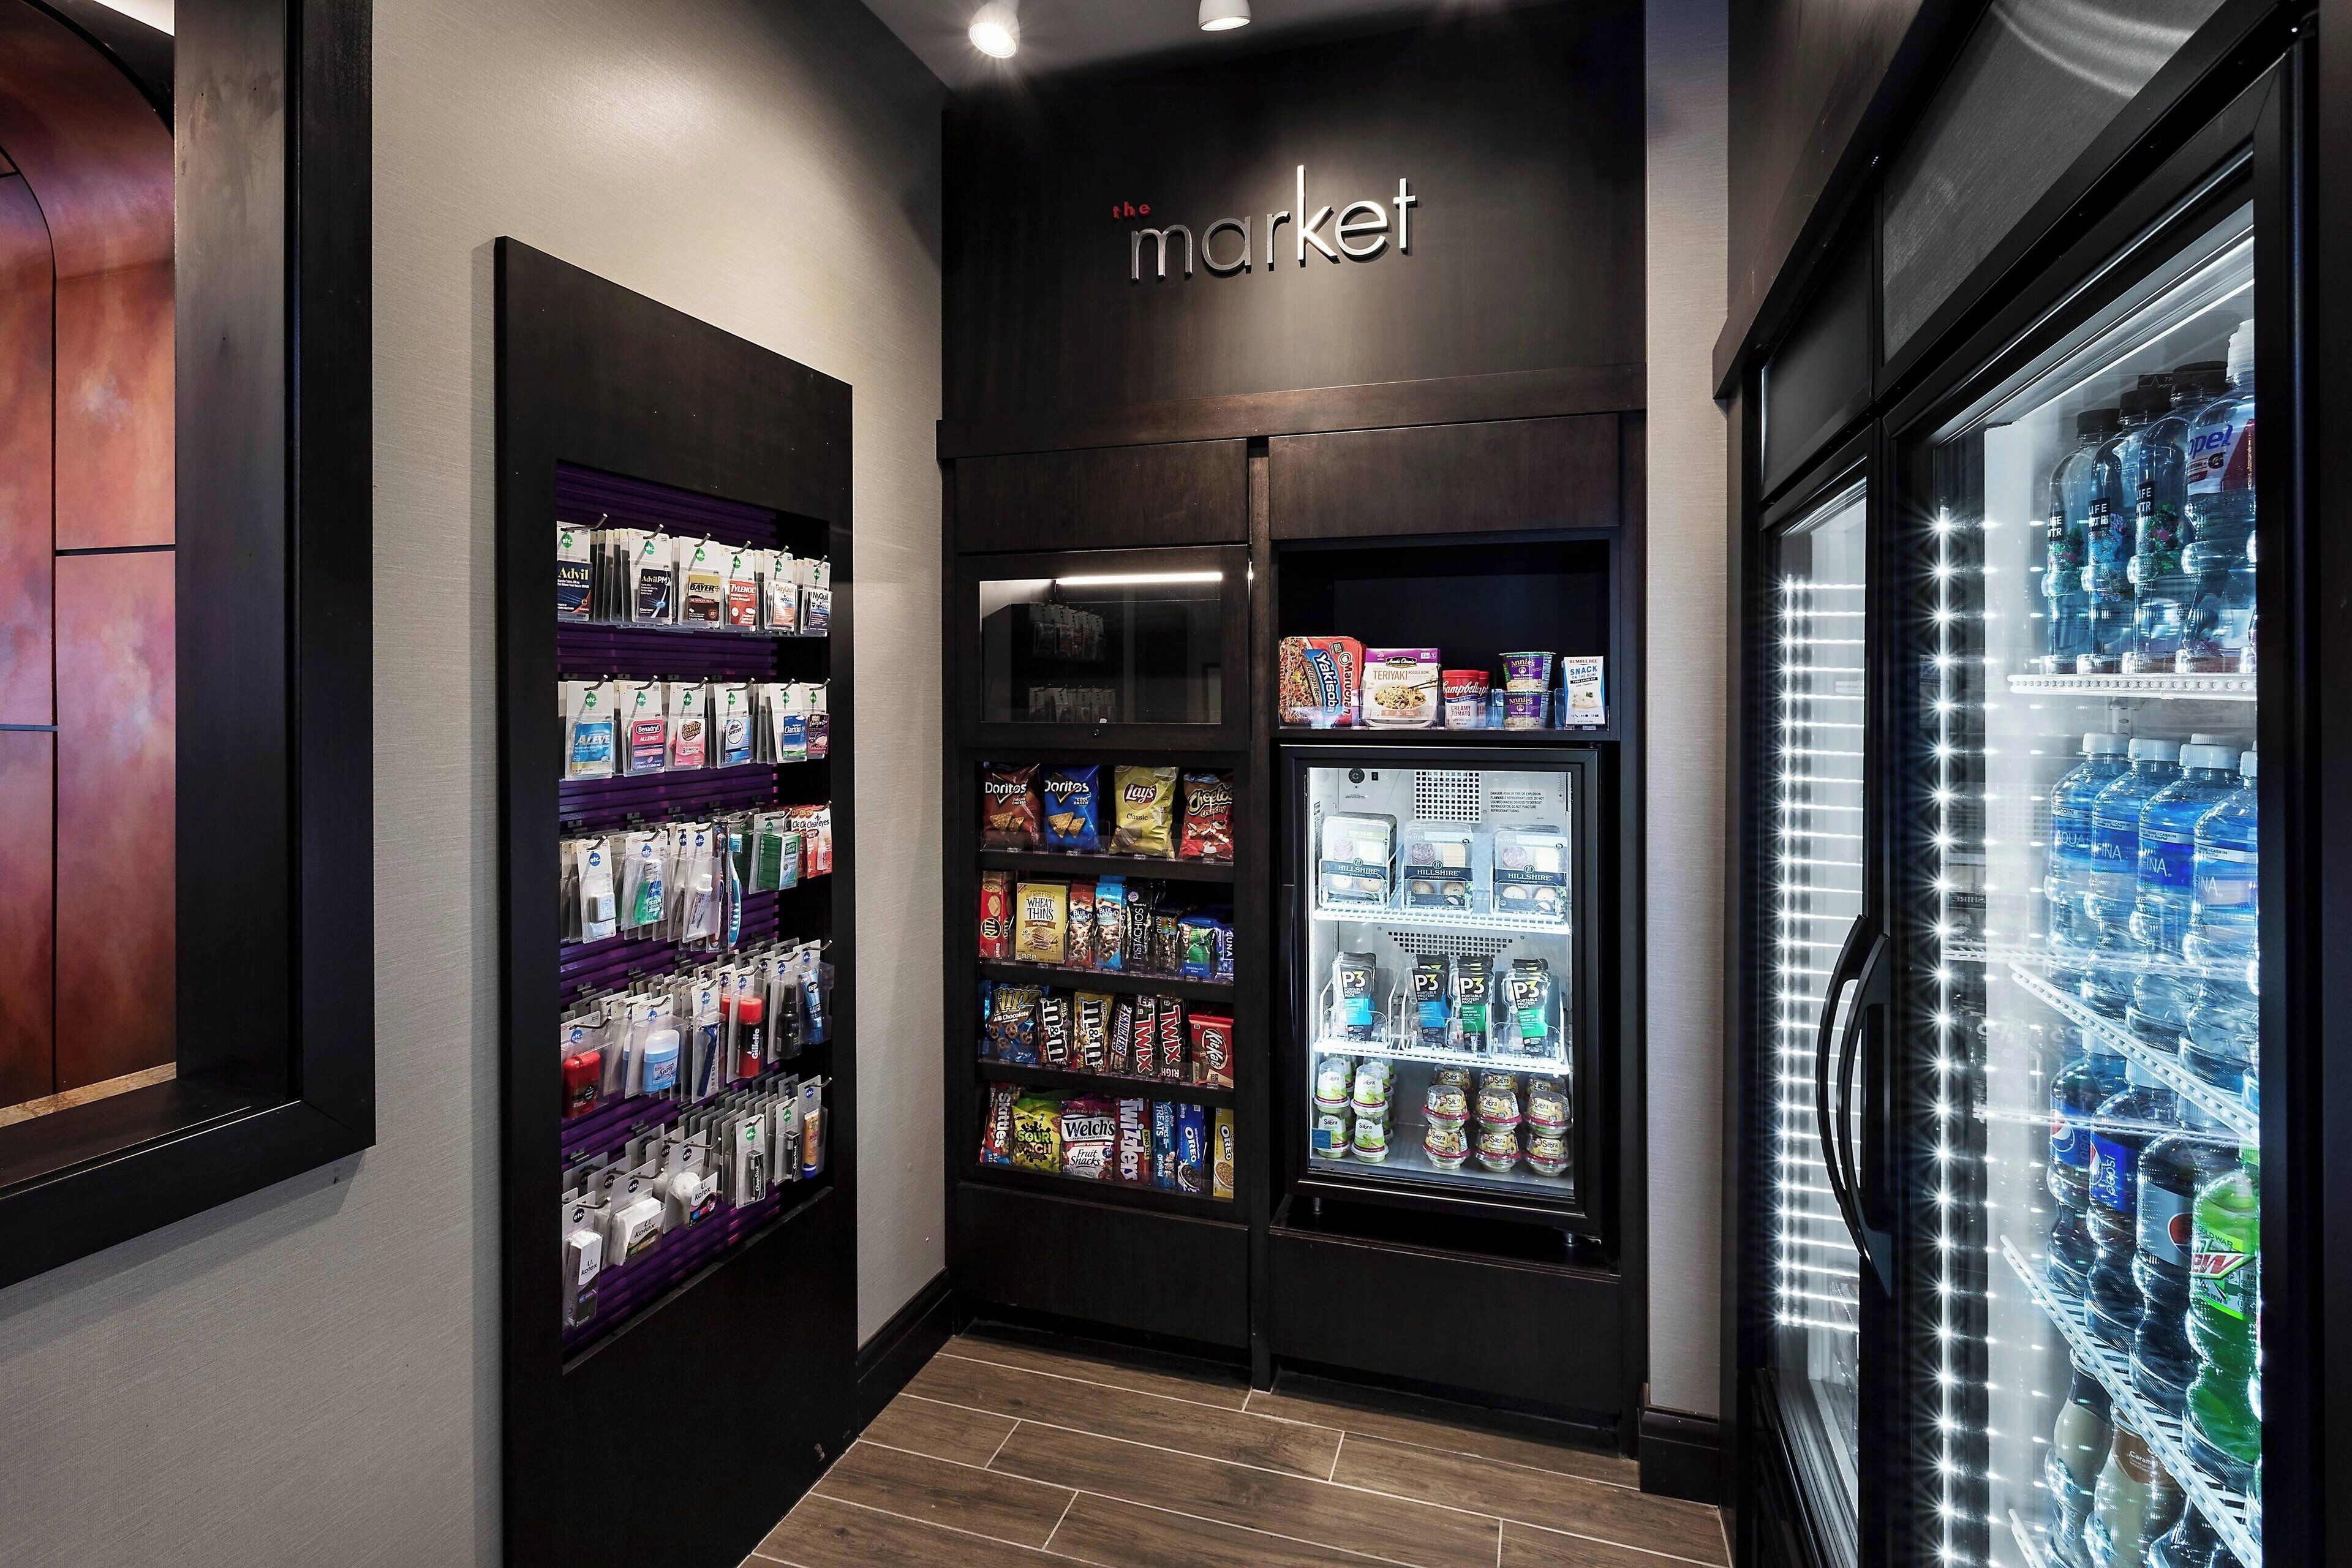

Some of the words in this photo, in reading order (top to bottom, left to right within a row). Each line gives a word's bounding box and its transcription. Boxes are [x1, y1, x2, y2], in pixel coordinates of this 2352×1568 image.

[1112, 201, 1152, 219] the
[1131, 164, 1417, 281] market
[2089, 503, 2107, 515] LIFE
[557, 567, 589, 581] Advil
[730, 584, 756, 594] TYLENOL
[812, 591, 829, 601] NyQuil
[1511, 658, 1536, 667] Annie's
[1306, 665, 1317, 688] Teriyaki
[1373, 670, 1408, 680] TERIYAKI
[1570, 665, 1597, 676] SNACK
[1316, 653, 1338, 712] Yakisoba
[1343, 662, 1353, 715] Maruchan
[1509, 696, 1534, 705] Annie's
[638, 723, 660, 733] Benadryl
[682, 722, 701, 733] Pepto-
[684, 728, 701, 737] Bismol
[728, 727, 742, 737] Seltzer
[784, 725, 801, 734] Claritin
[576, 734, 611, 745] ALEVE
[985, 781, 1027, 794] Doritos
[1044, 780, 1090, 793] Doritos
[1125, 784, 1155, 804] Lay's
[1188, 783, 1234, 816] Cheetos
[1126, 812, 1148, 821] Classic
[1200, 805, 1226, 818] Crunchy
[2052, 806, 2075, 815] PEPCOIN
[1338, 865, 1378, 875] HILLSHIRE
[1026, 897, 1054, 908] WHEAT
[1027, 907, 1054, 921] THiNS
[983, 919, 998, 939] RITZ
[1133, 908, 1144, 960] PISTACHIOS
[1341, 971, 1366, 988] P3
[1414, 974, 1439, 991] P3
[1460, 977, 1485, 994] P3
[1512, 980, 1540, 1000] P3
[993, 987, 1041, 1016] Flipz
[1003, 1011, 1029, 1020] Chocolate
[1122, 1005, 1132, 1013] 2
[1115, 1012, 1131, 1056] SNICKERS
[1160, 1005, 1181, 1065] TWIX
[752, 1028, 760, 1060] Gillette
[1135, 1014, 1155, 1073] TWIX
[995, 1092, 1011, 1148] Skittles
[1063, 1119, 1115, 1138] Welch's
[1017, 1131, 1051, 1143] SOUR
[1220, 1125, 1232, 1161] OREO
[1432, 1133, 1446, 1142] Sabra
[1489, 1134, 1506, 1144] Sabra
[1017, 1140, 1052, 1155] PATCH
[1185, 1126, 1197, 1163] OREO
[1542, 1140, 1558, 1149] Sabra
[1077, 1148, 1098, 1158] Fruit
[1069, 1155, 1101, 1166] Snacks
[2105, 1154, 2119, 1198] pepsi
[694, 1186, 711, 1201] kotex
[574, 1212, 585, 1221] etc.
[634, 1222, 655, 1238] kotex
[2214, 1235, 2234, 1248] WAR
[581, 1262, 597, 1276] kotex
